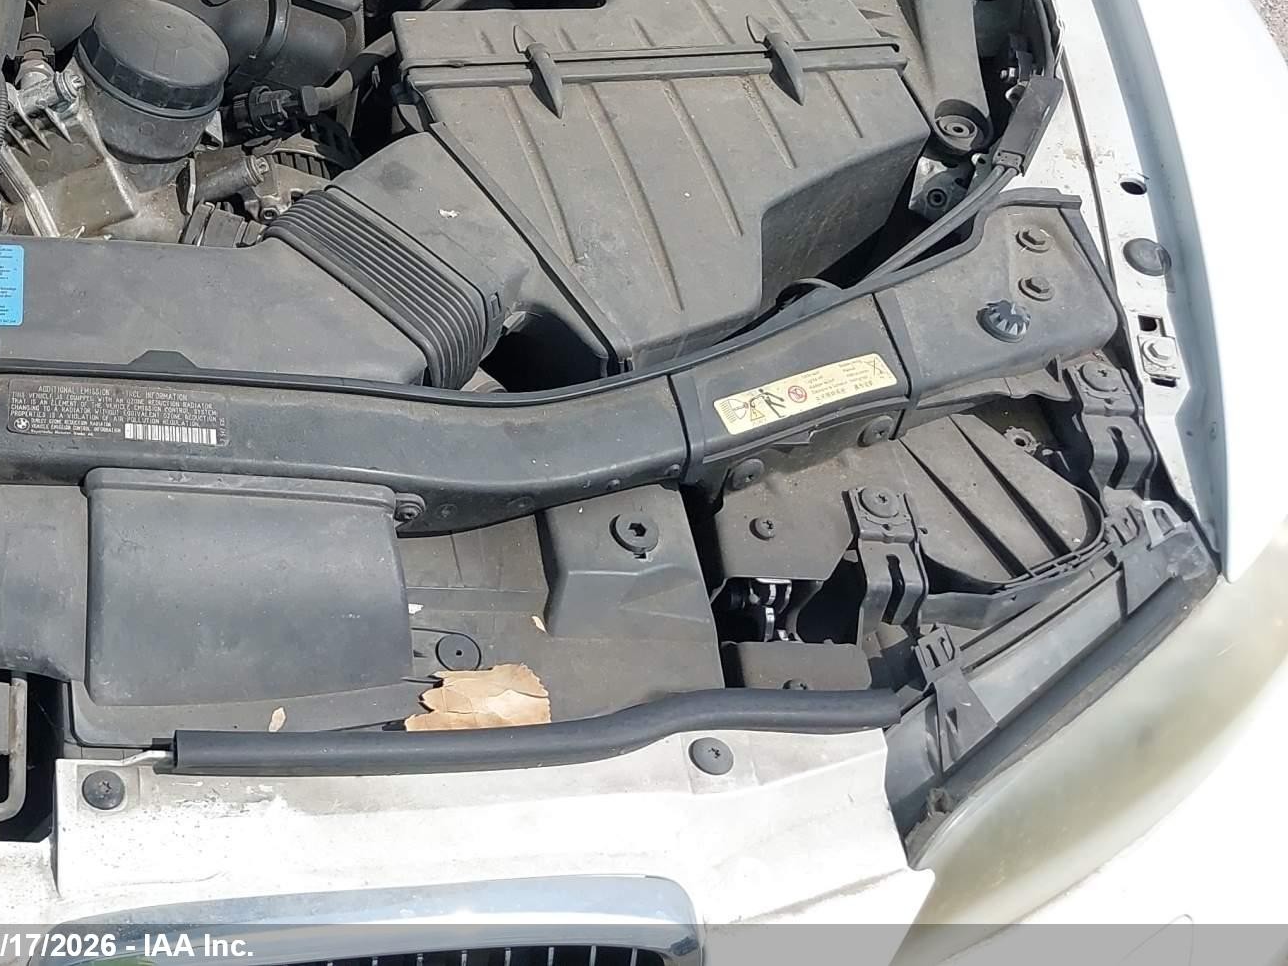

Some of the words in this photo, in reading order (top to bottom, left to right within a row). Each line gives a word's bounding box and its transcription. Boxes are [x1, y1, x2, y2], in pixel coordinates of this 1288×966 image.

[38, 386, 75, 394] ADDITIONAL
[80, 386, 110, 395] EMISSION
[145, 391, 188, 400] INFORMATION
